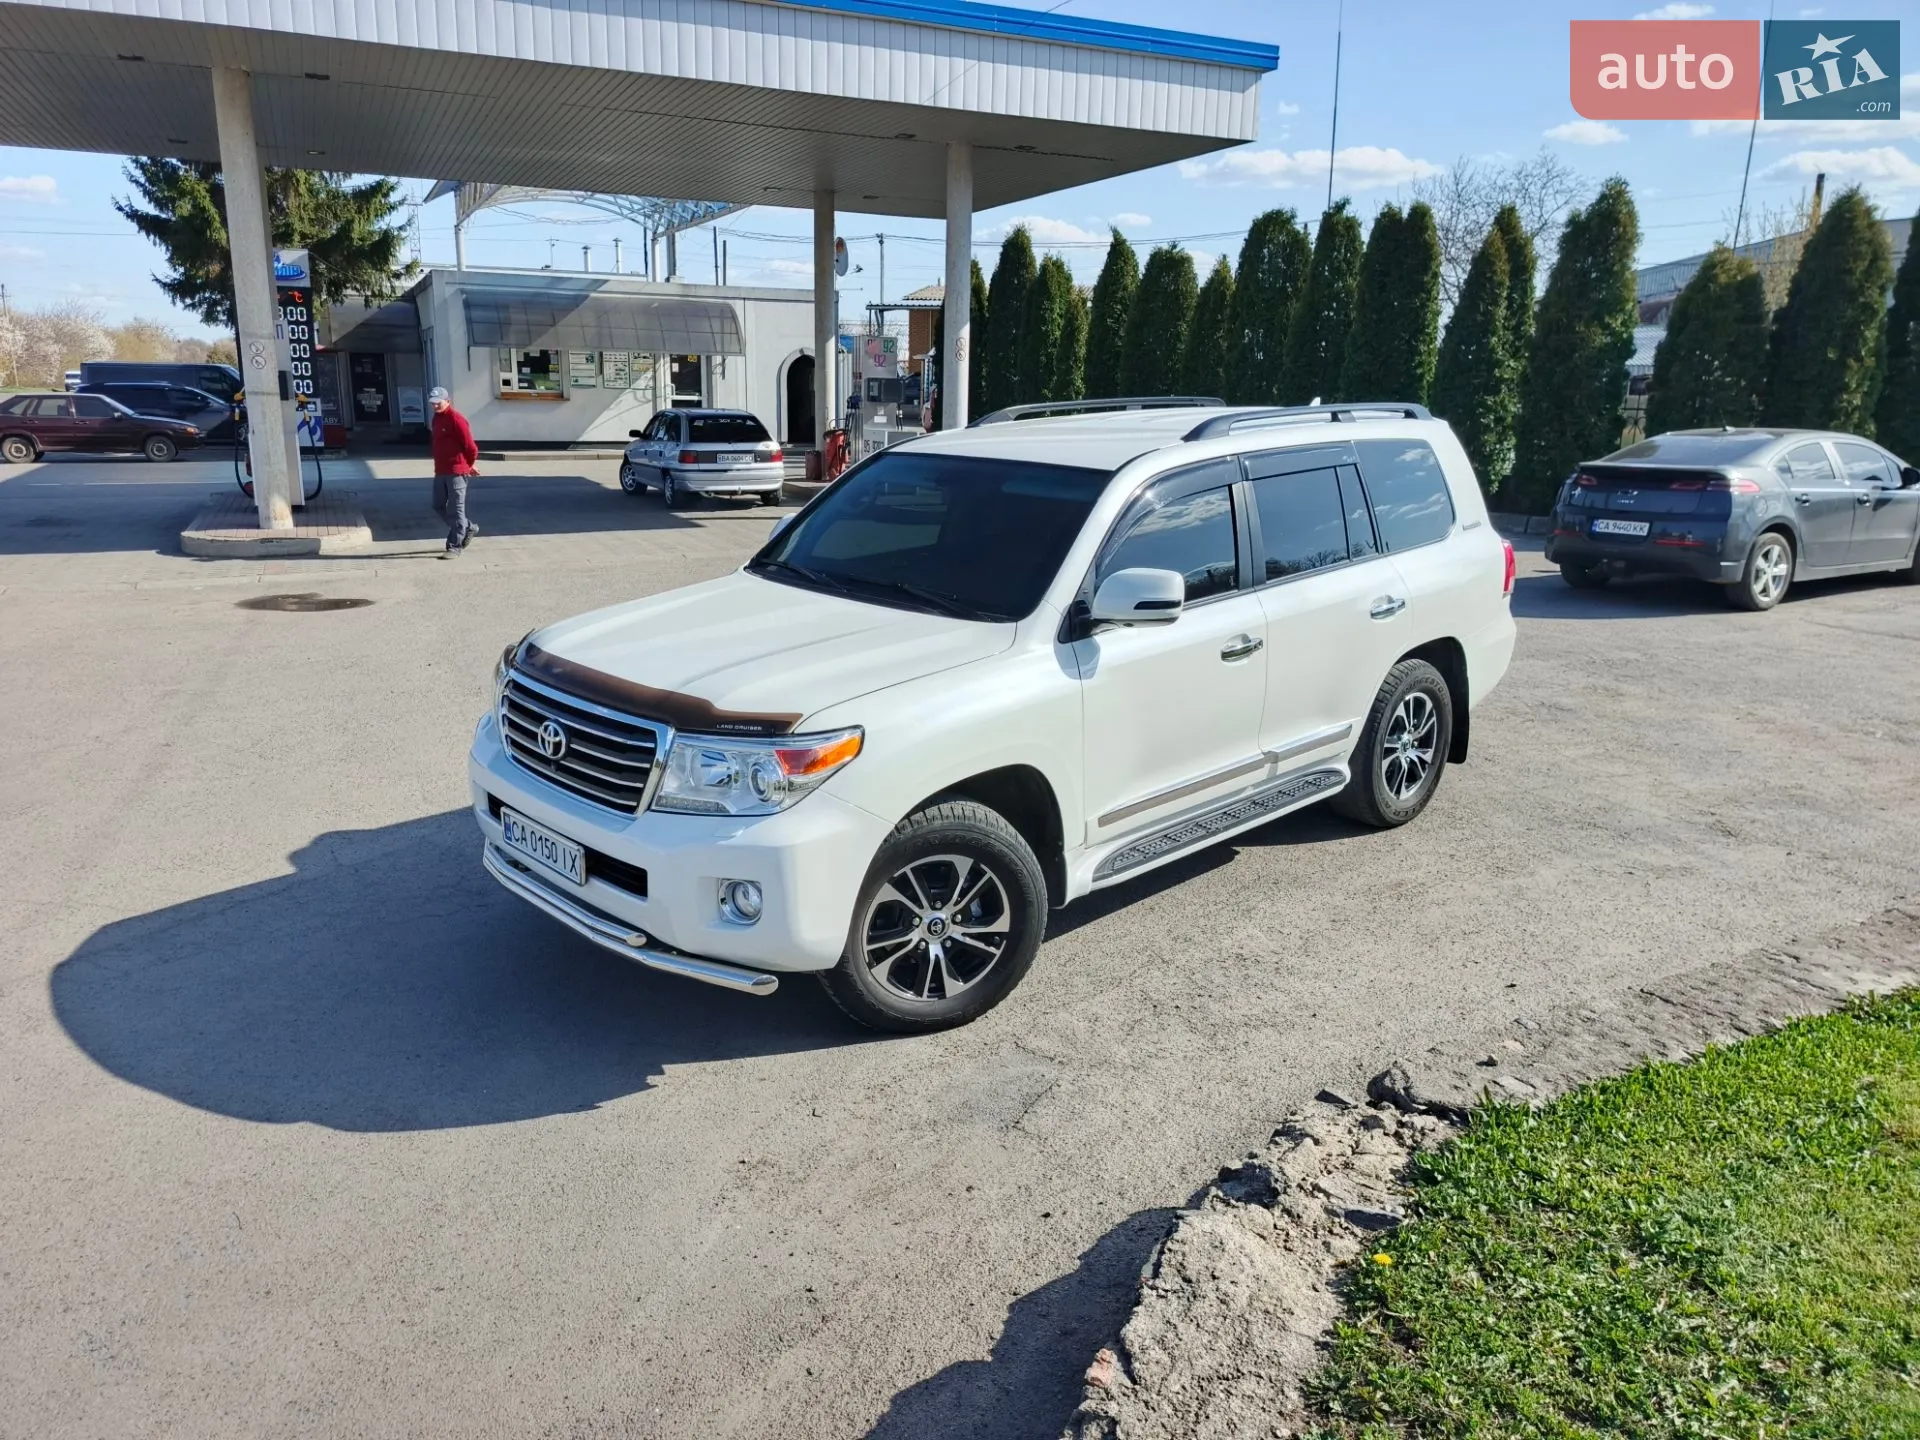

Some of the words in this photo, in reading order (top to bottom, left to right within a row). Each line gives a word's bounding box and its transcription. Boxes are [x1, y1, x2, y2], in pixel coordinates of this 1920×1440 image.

[883, 339, 895, 353] 92
[874, 354, 886, 367] 92
[511, 818, 528, 848] CA
[530, 830, 558, 864] 0150
[563, 847, 578, 877] IX
